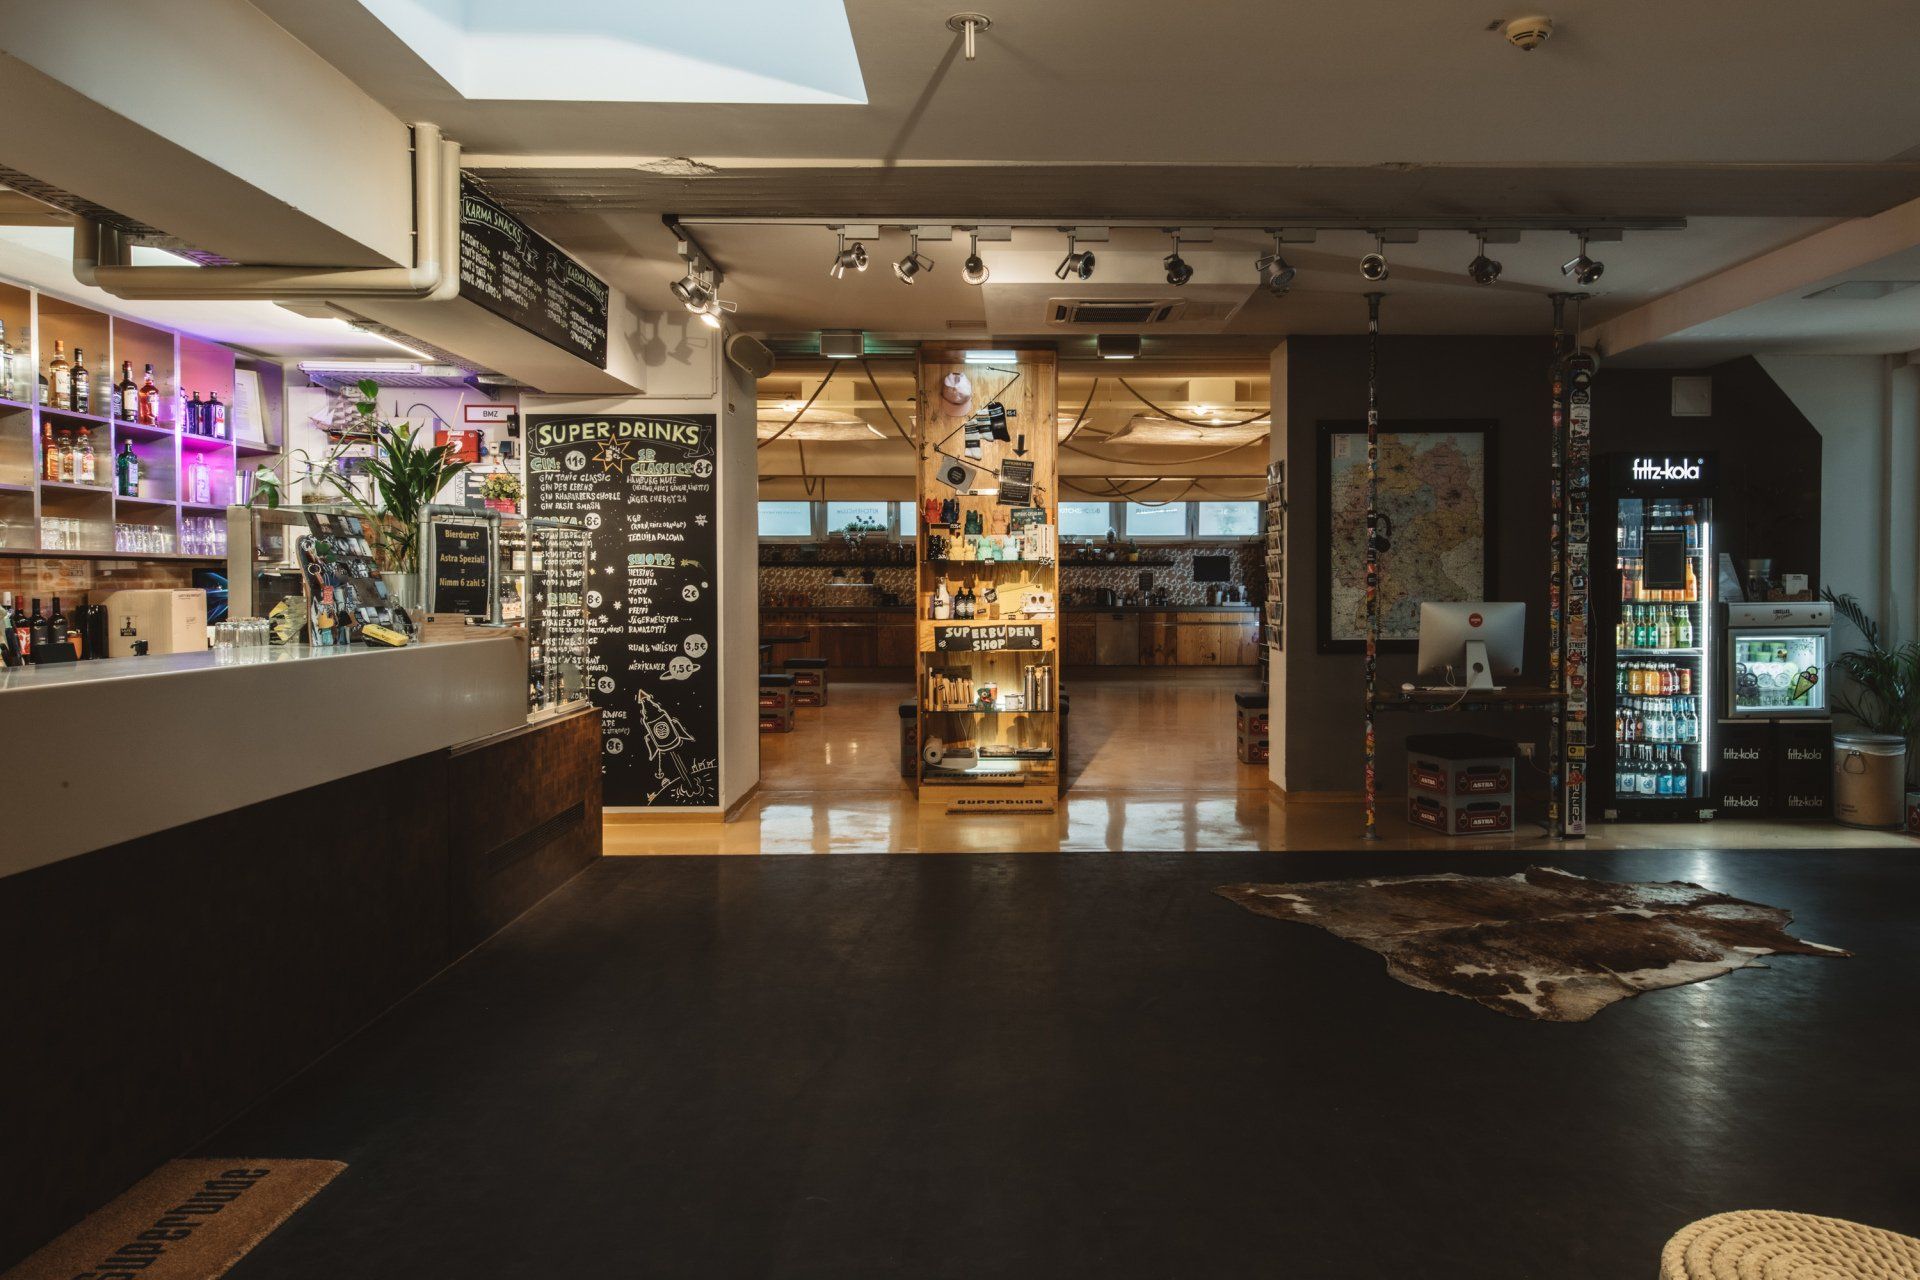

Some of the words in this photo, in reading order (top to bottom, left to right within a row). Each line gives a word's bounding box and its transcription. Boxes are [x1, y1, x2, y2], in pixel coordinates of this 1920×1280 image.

[465, 200, 493, 223] KARMA
[494, 212, 522, 243] SNACKS
[567, 264, 586, 285] KARMA
[586, 276, 605, 303] DRINKS
[539, 422, 610, 445] SUPER
[619, 422, 699, 445] DRINKS
[530, 457, 560, 471] GIN:
[1632, 458, 1700, 480] fritz-kola
[576, 502, 601, 510] SMASH
[444, 529, 480, 539] Bierdurst?
[627, 532, 656, 542] TEQUILA
[657, 533, 684, 541] PALOMA
[440, 553, 458, 562] Astra
[459, 554, 485, 564] Spezial!
[628, 553, 675, 566] SHOTS:
[439, 578, 459, 586] Nimm
[460, 578, 465, 587] 6
[466, 579, 480, 587] zahl
[481, 579, 486, 587] 5
[684, 589, 697, 599] 2€
[628, 597, 652, 605] VODKA
[945, 626, 1035, 639] SUPERBUDEN
[972, 639, 1006, 651] SHOP
[1723, 747, 1759, 760] fritz-kola
[1787, 747, 1822, 760] fritz-kola
[1420, 777, 1436, 785] ASTRA
[1571, 764, 1581, 823] carhat
[1723, 795, 1759, 807] fritz-kola
[1788, 795, 1823, 807] fritz-kola
[1421, 813, 1436, 821] ASTRA
